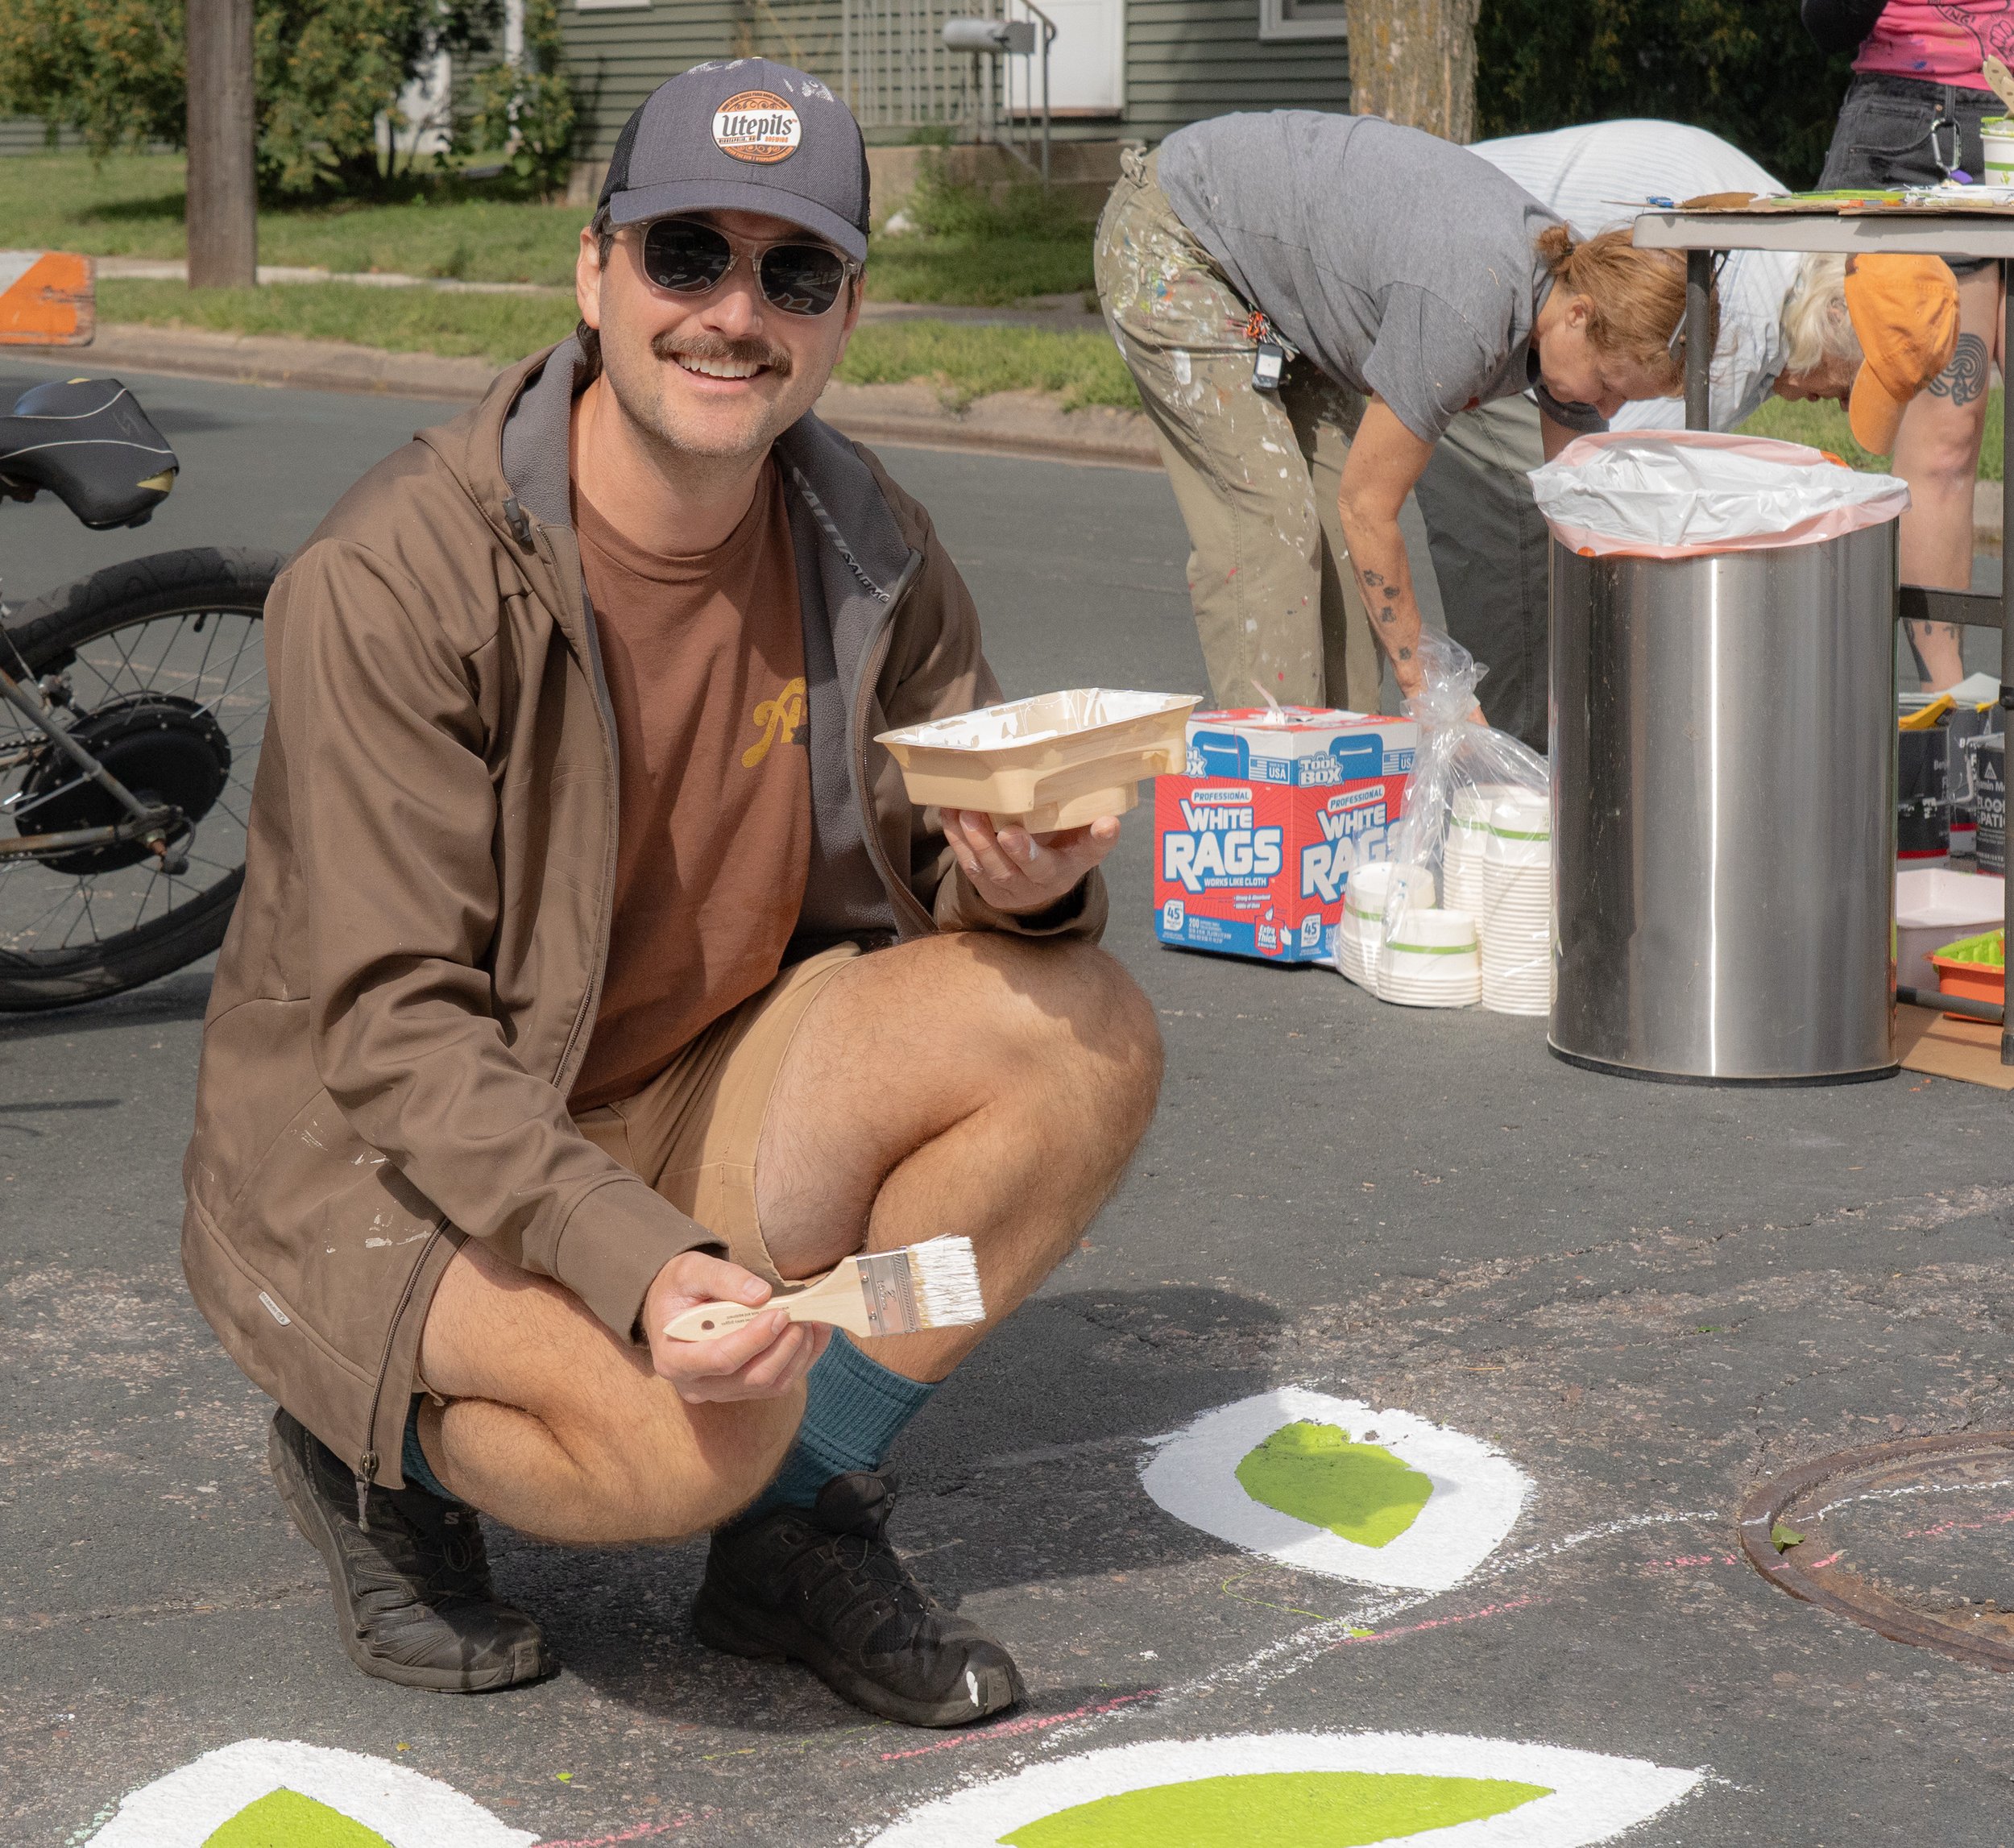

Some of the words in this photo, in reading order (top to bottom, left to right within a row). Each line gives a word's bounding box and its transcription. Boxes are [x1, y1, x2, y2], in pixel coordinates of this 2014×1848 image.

[722, 114, 793, 141] Utepils
[1299, 757, 1340, 770] TOOL
[1268, 767, 1287, 780] USA
[1300, 768, 1341, 785] BOX
[1193, 791, 1249, 802] PROFESSIONAL
[1330, 787, 1383, 810] PROFESSIONAL
[1179, 800, 1253, 833] WHITE
[1316, 803, 1386, 841] WHITE
[1980, 811, 2005, 828] PATI
[1165, 828, 1281, 891] RAGS
[1204, 877, 1228, 887] WORKS
[1229, 876, 1244, 886] LIKE
[1245, 876, 1266, 886] CLOTH
[1167, 906, 1180, 920] 45
[1188, 918, 1200, 929] 200
[1304, 922, 1317, 935] 45
[1259, 924, 1276, 937] Extra
[1258, 932, 1278, 945] Thick
